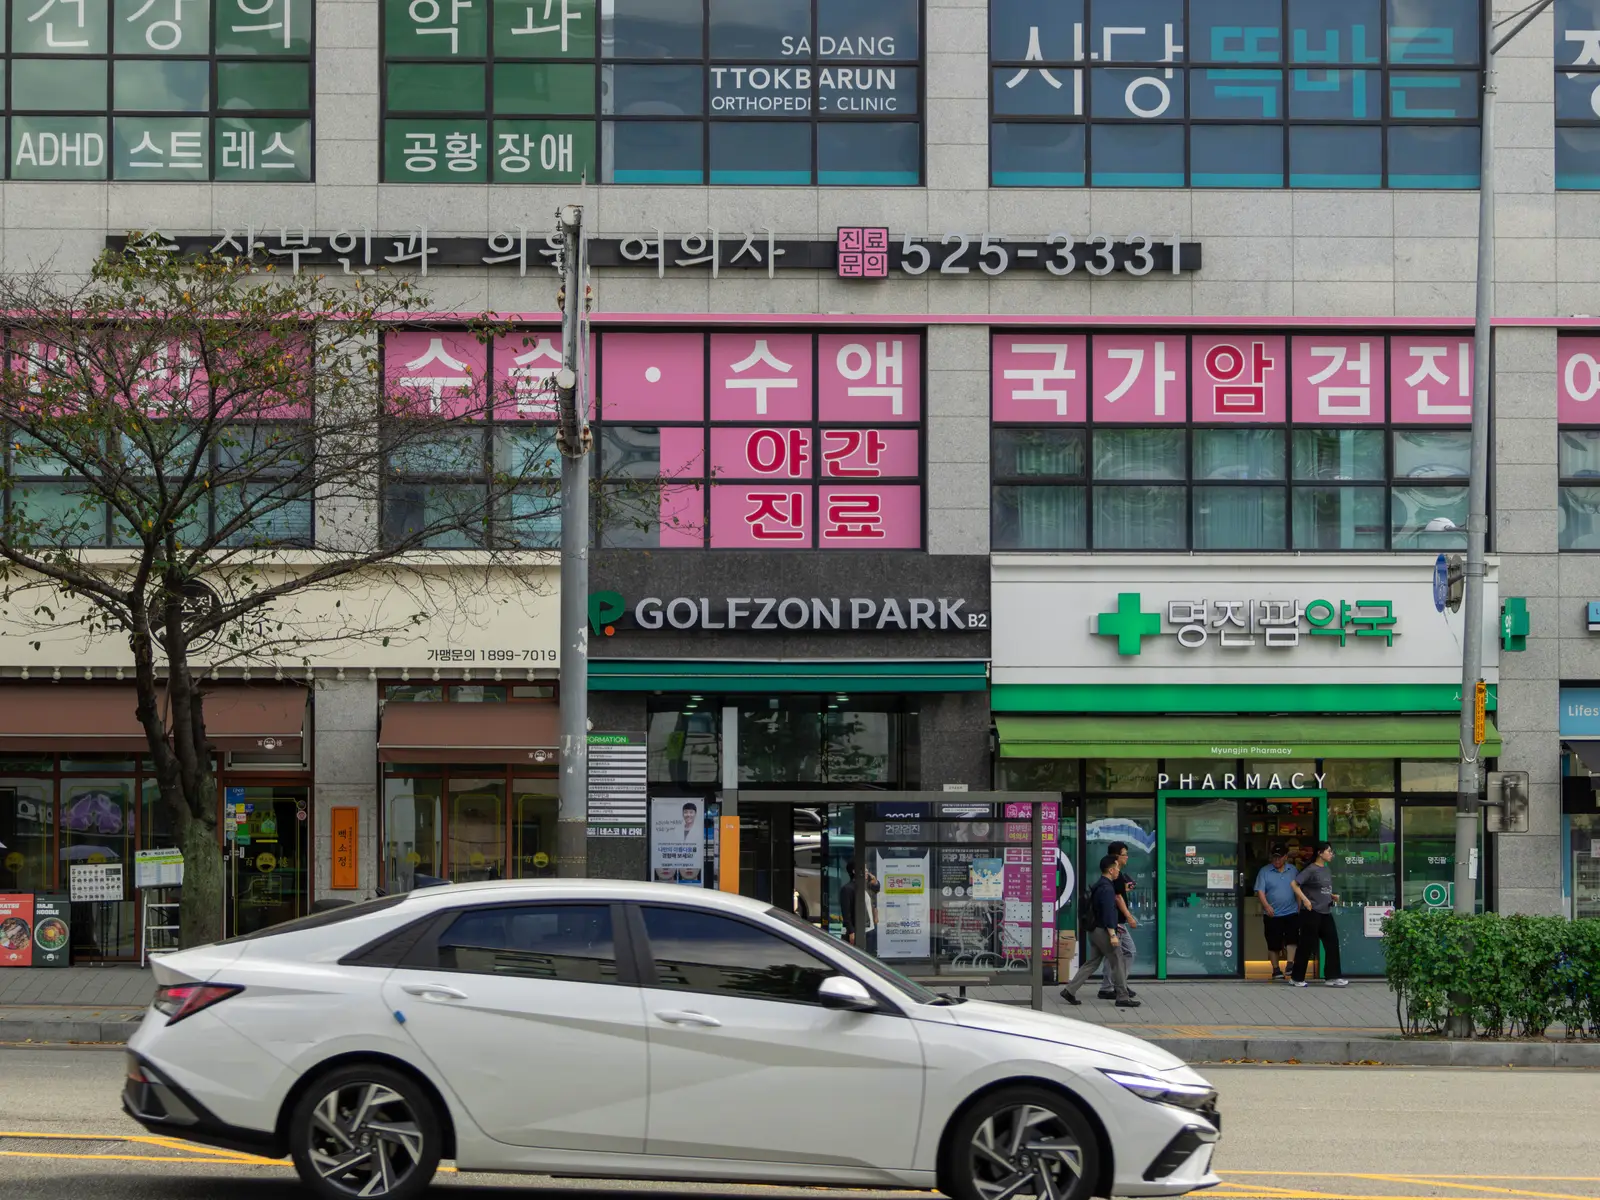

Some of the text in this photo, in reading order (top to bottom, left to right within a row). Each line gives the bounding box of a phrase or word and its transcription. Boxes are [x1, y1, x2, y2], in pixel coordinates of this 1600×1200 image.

[781, 36, 895, 56] SADANG
[711, 68, 896, 90] TTOKBARUN
[711, 96, 897, 111] ORTHOPEDIC CLINIC
[16, 131, 295, 170] ADHD 스트레스
[403, 132, 573, 173] 공황장애
[619, 224, 786, 279] 여의사
[841, 230, 888, 251] 진료
[901, 232, 1182, 276] 525-3331
[841, 254, 886, 275] 문의
[725, 340, 903, 415] 수액
[745, 429, 887, 477] 야간
[744, 492, 886, 541] 진료
[635, 597, 988, 630] GOLFZON PARK B2
[1167, 598, 1398, 649] 명진팜약국
[427, 649, 557, 662] 가맹문의 1899-7019
[1210, 746, 1293, 756] Myungjin Pharmacy
[1157, 773, 1328, 791] PHARMACY
